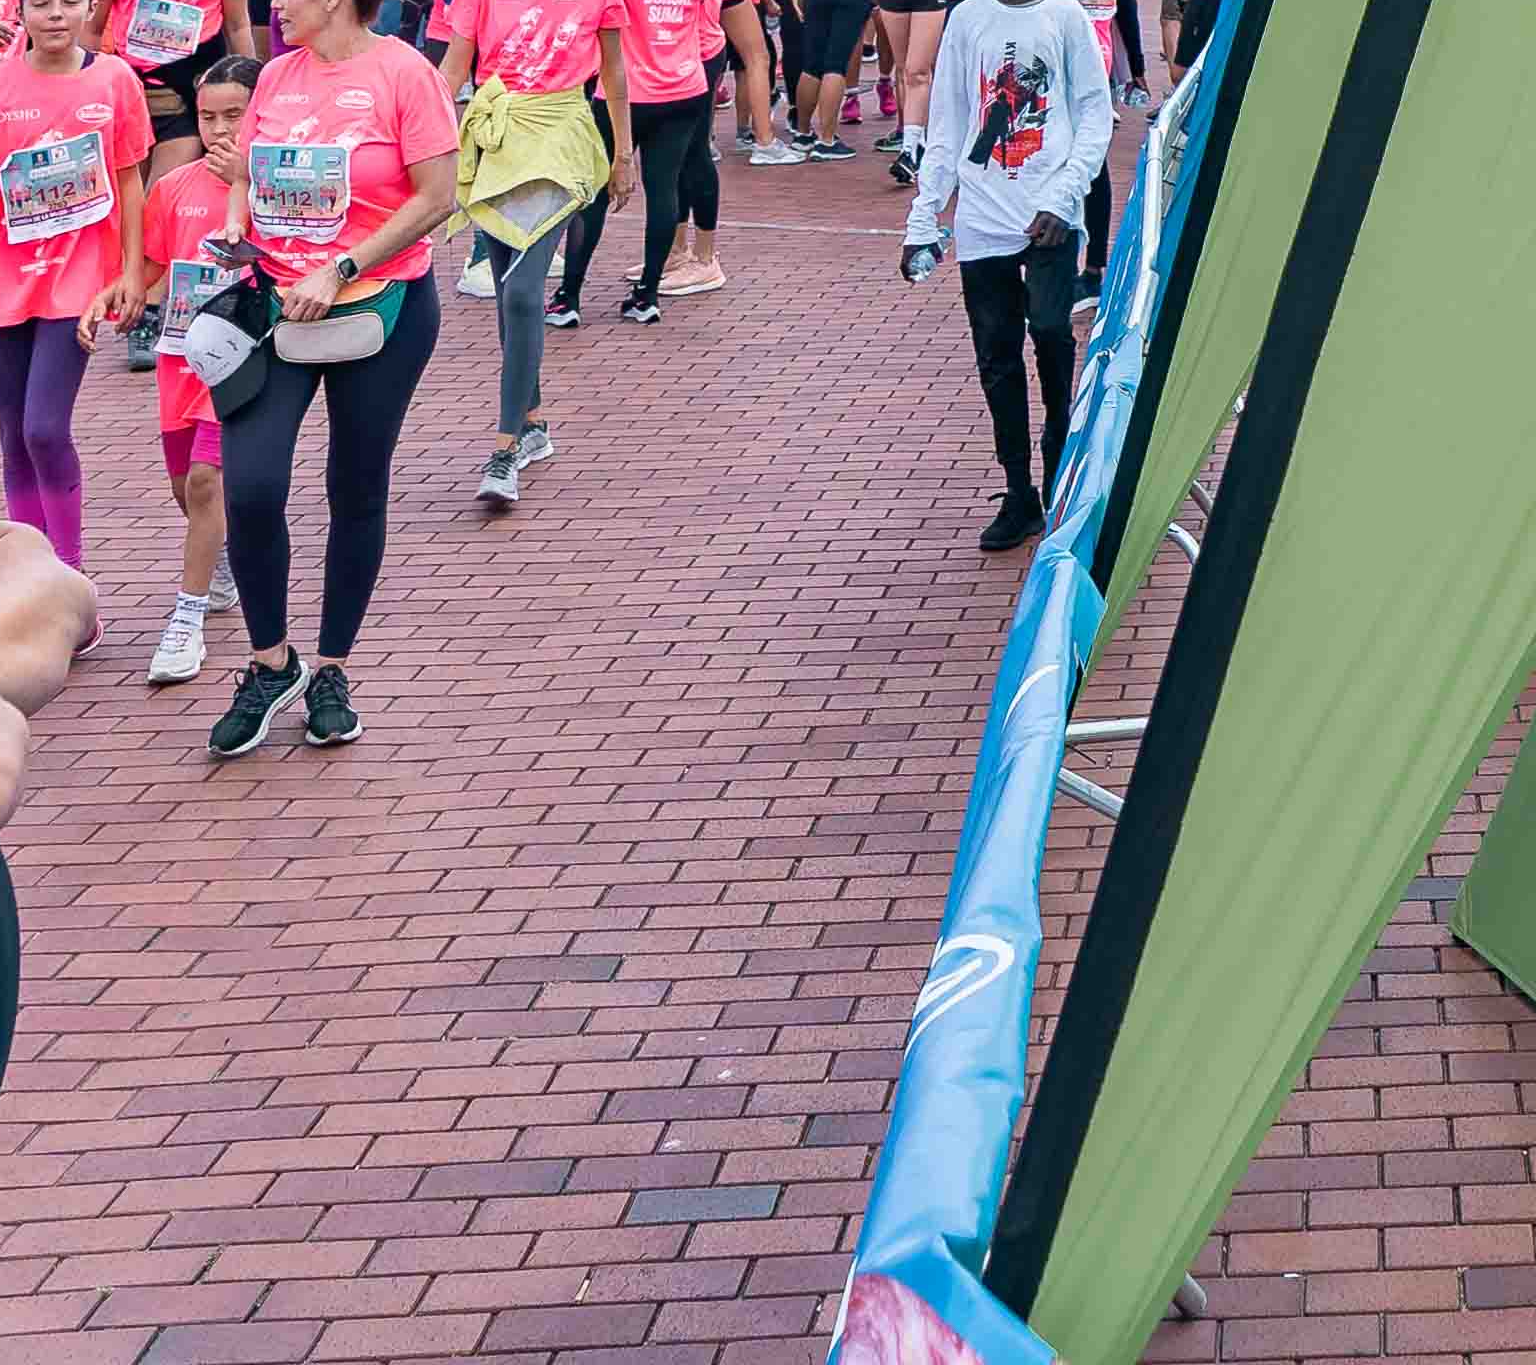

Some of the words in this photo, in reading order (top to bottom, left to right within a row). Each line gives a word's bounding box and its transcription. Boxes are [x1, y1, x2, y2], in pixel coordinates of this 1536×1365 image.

[648, 4, 683, 23] SUMA
[35, 181, 76, 203] 112
[279, 190, 313, 207] 112
